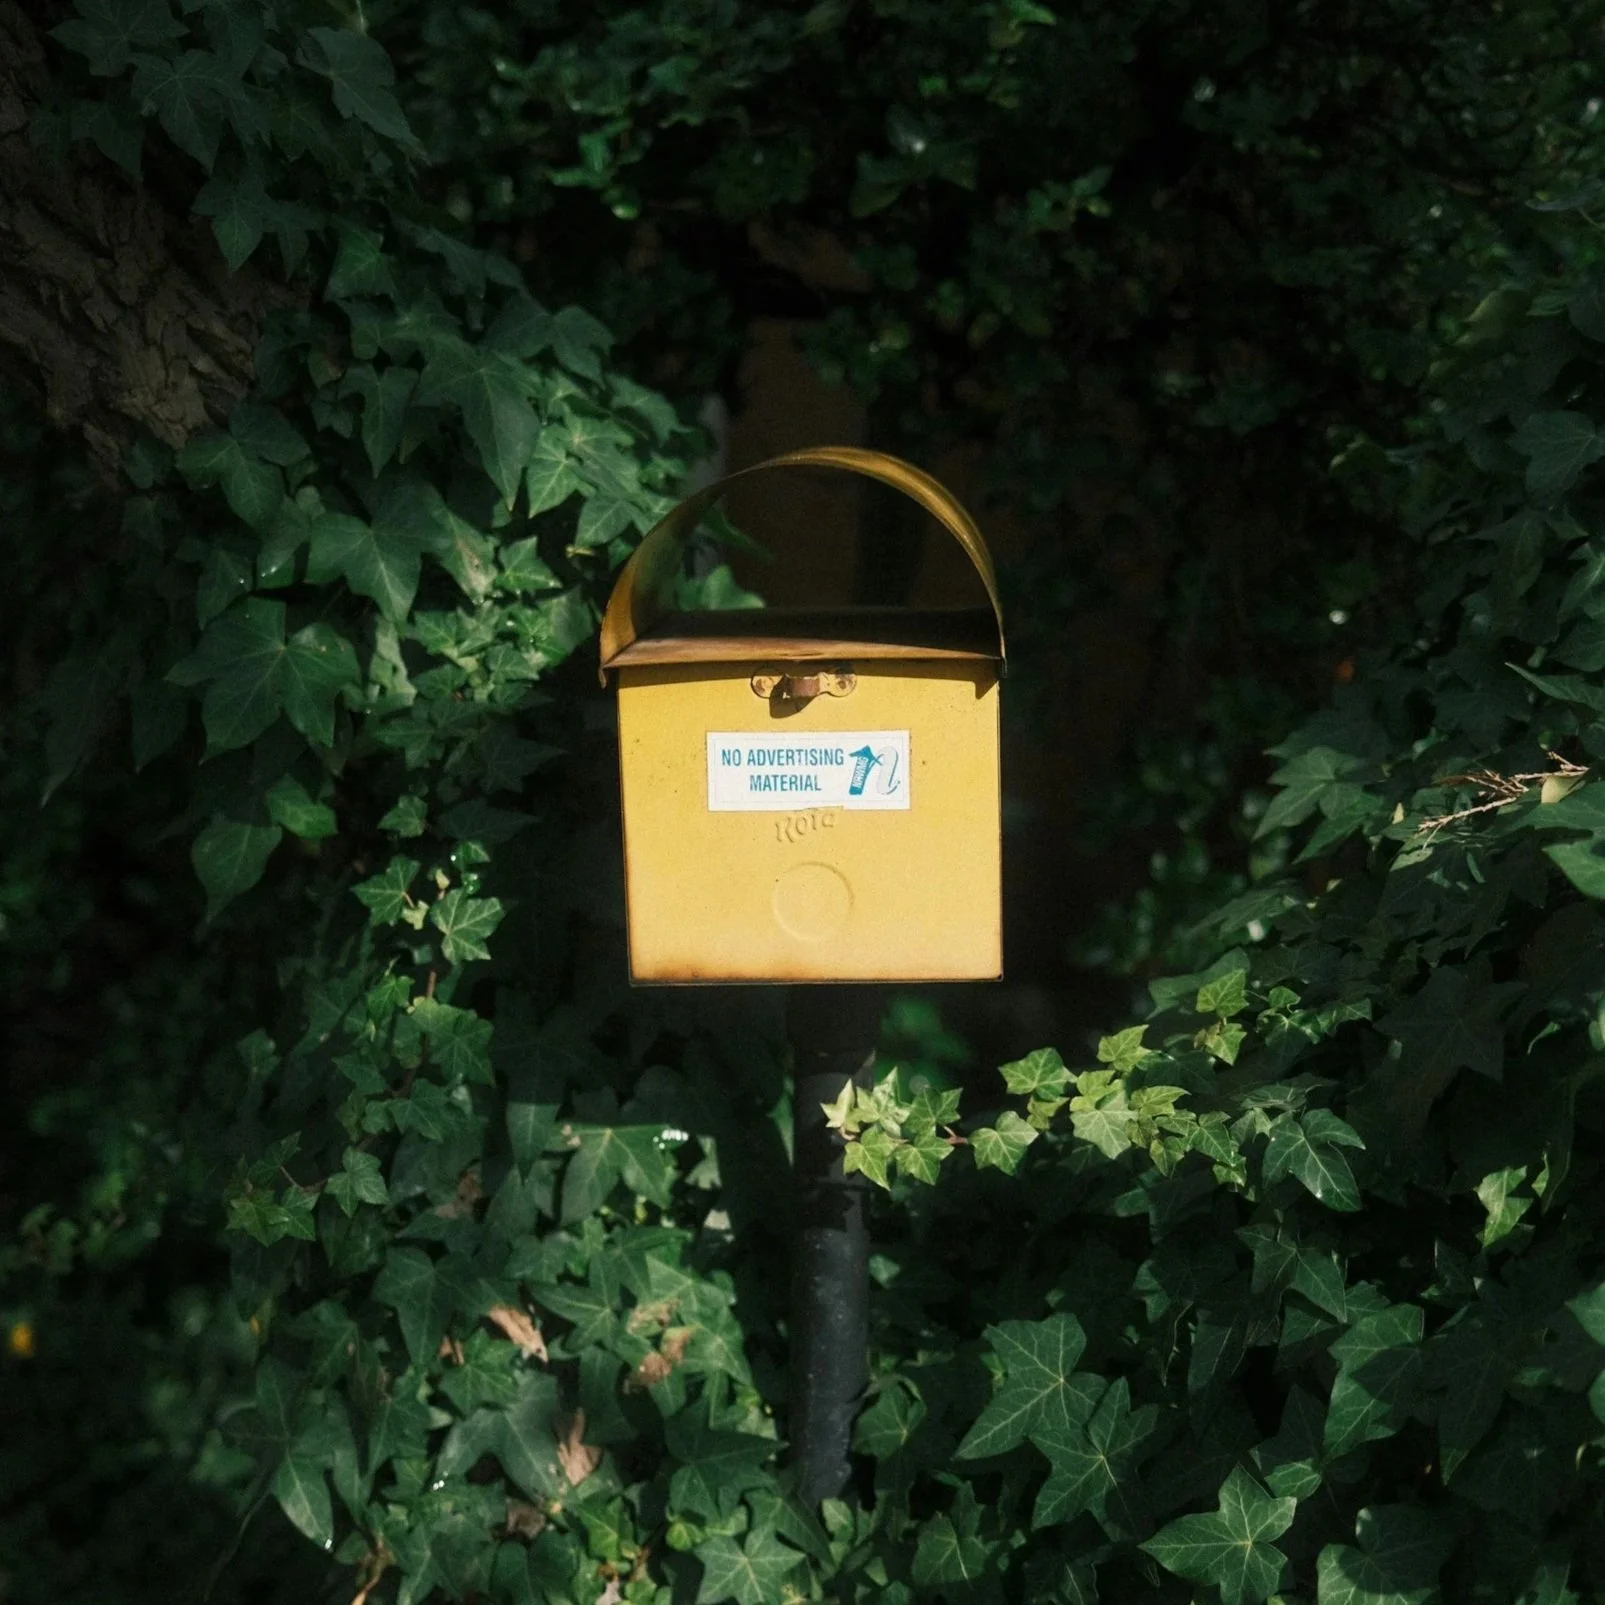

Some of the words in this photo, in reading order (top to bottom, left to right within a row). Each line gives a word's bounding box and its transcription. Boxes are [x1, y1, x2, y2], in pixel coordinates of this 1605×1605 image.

[721, 748, 742, 767] NO
[747, 748, 845, 767] ADVERTISING
[749, 773, 823, 792] MATERIAL
